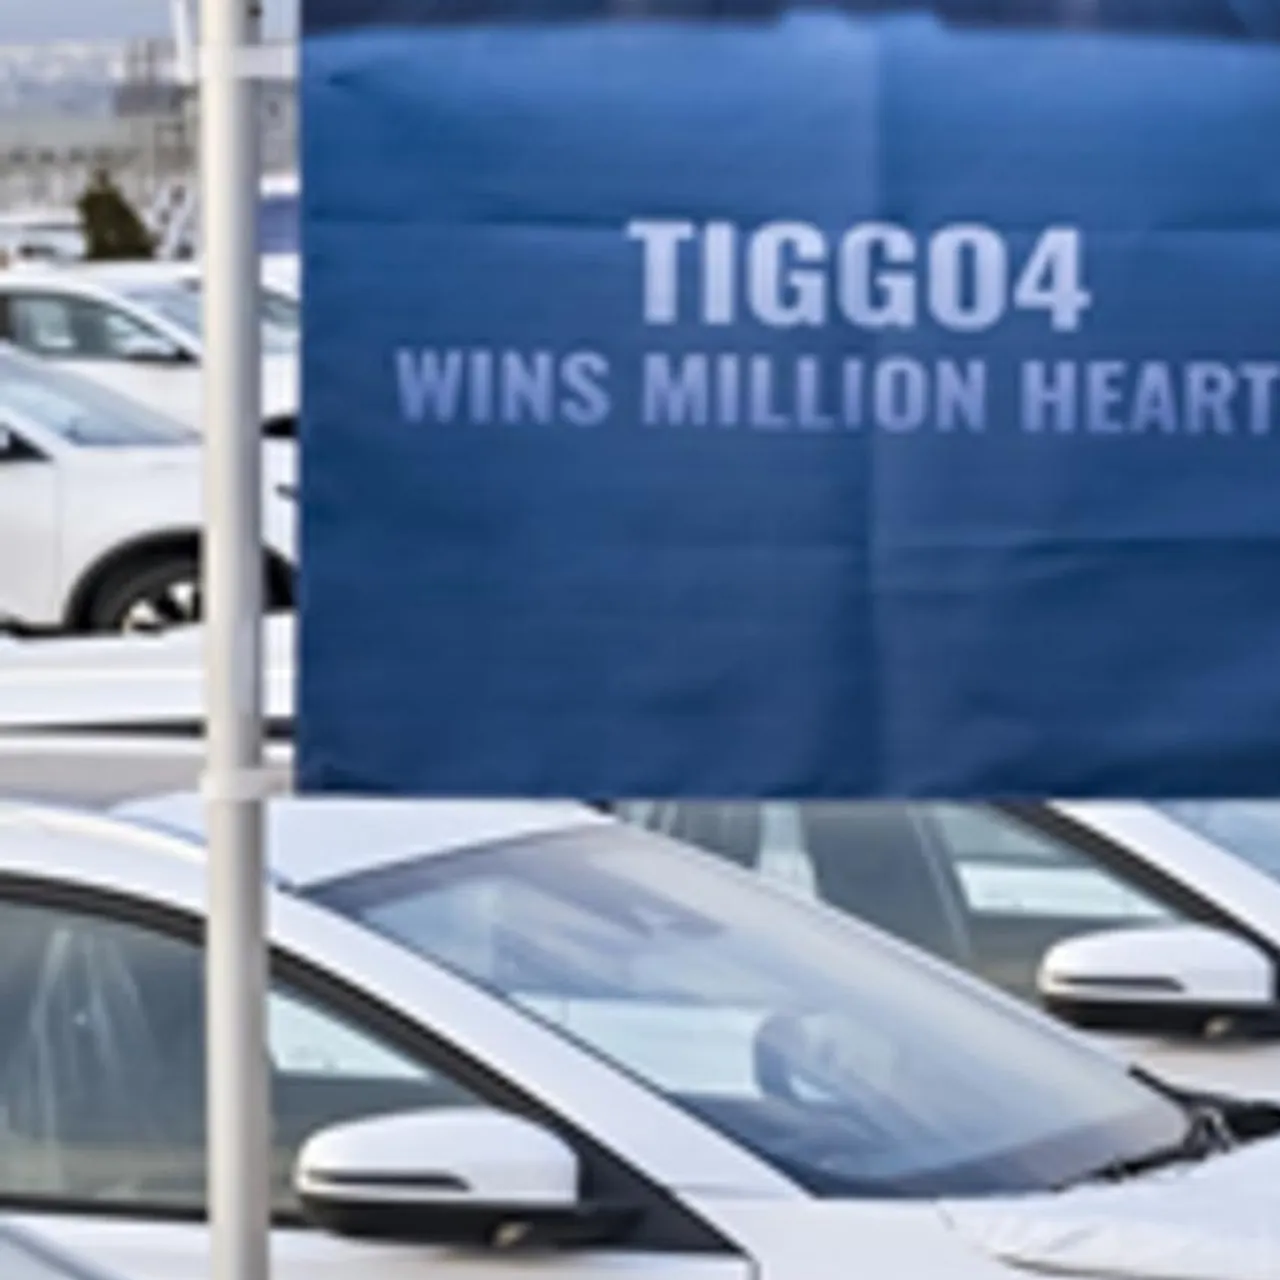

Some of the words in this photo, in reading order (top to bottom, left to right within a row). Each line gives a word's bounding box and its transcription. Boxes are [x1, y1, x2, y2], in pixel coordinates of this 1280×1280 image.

[625, 218, 1093, 332] TIGGO4
[397, 349, 612, 425] WINS
[640, 352, 988, 433] MILLION
